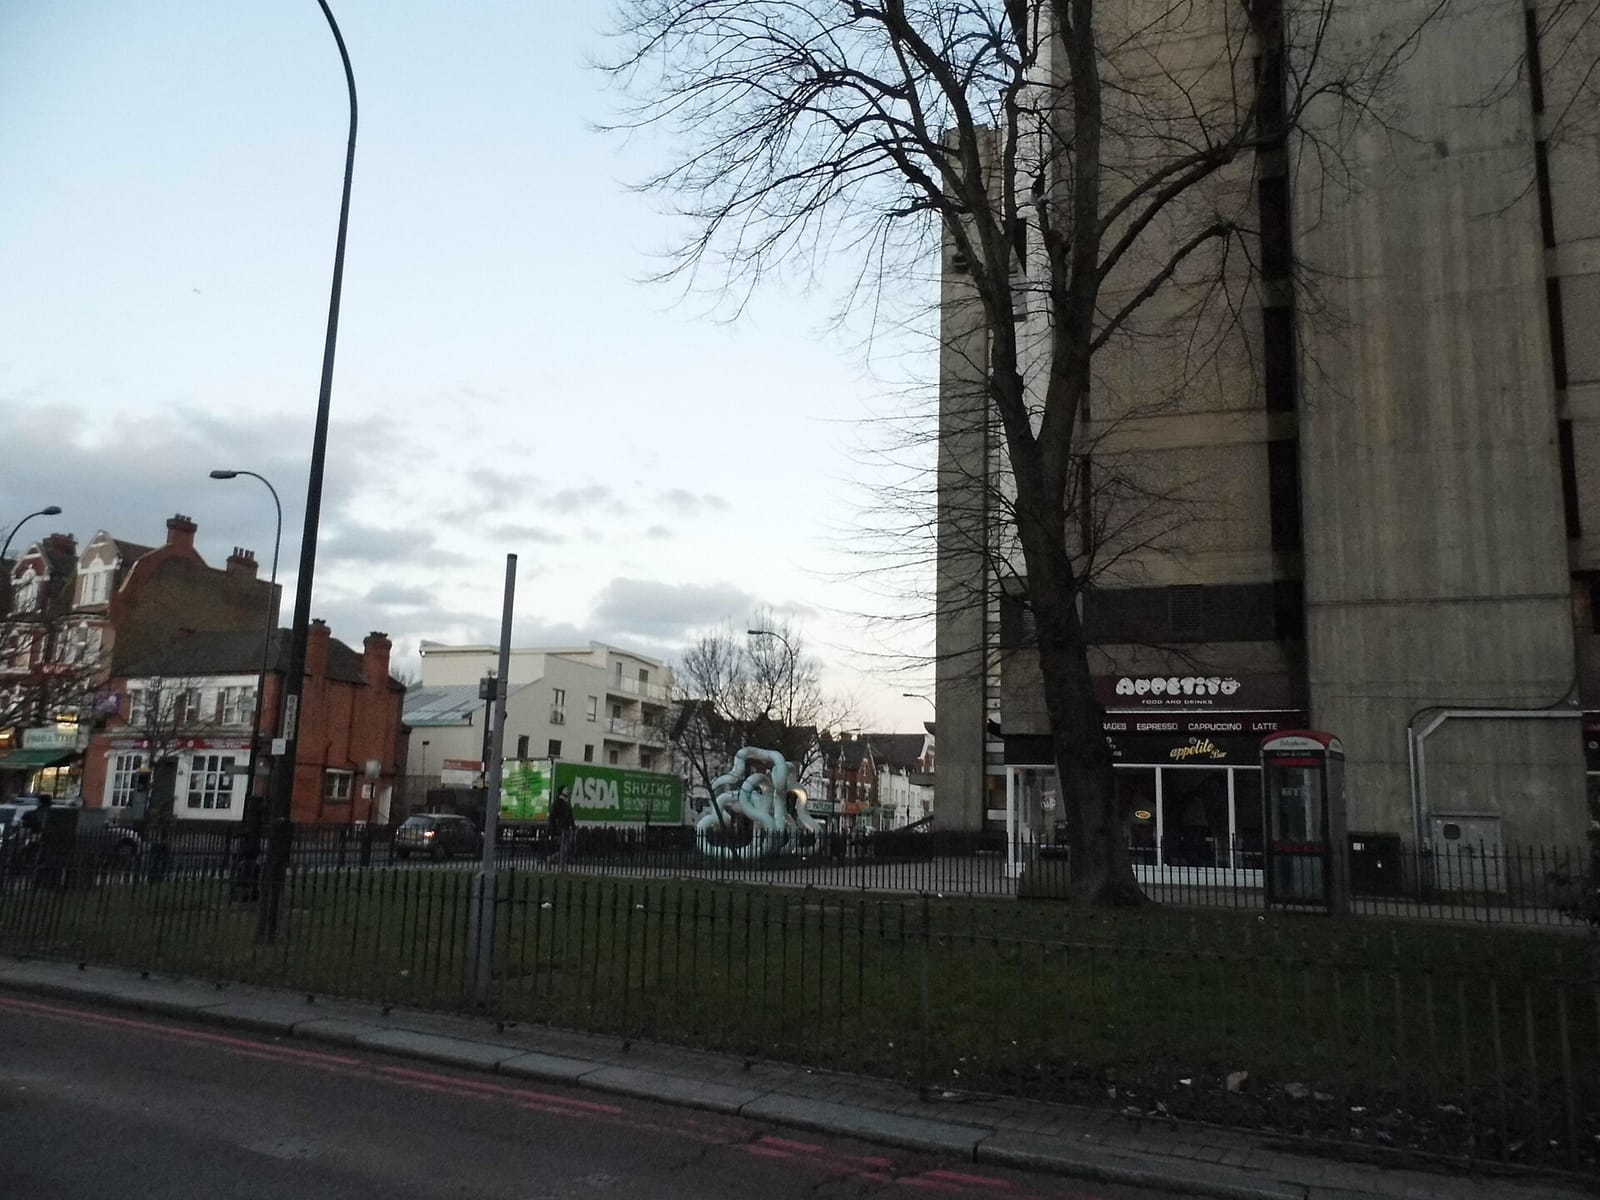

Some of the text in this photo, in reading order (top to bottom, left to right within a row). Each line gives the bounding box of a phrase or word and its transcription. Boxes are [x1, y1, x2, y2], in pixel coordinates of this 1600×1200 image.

[1136, 723, 1179, 731] ESPRESSO
[1188, 723, 1242, 731] CAPPUCCINO
[1252, 723, 1278, 731] LATTE
[570, 776, 620, 810] ASDA
